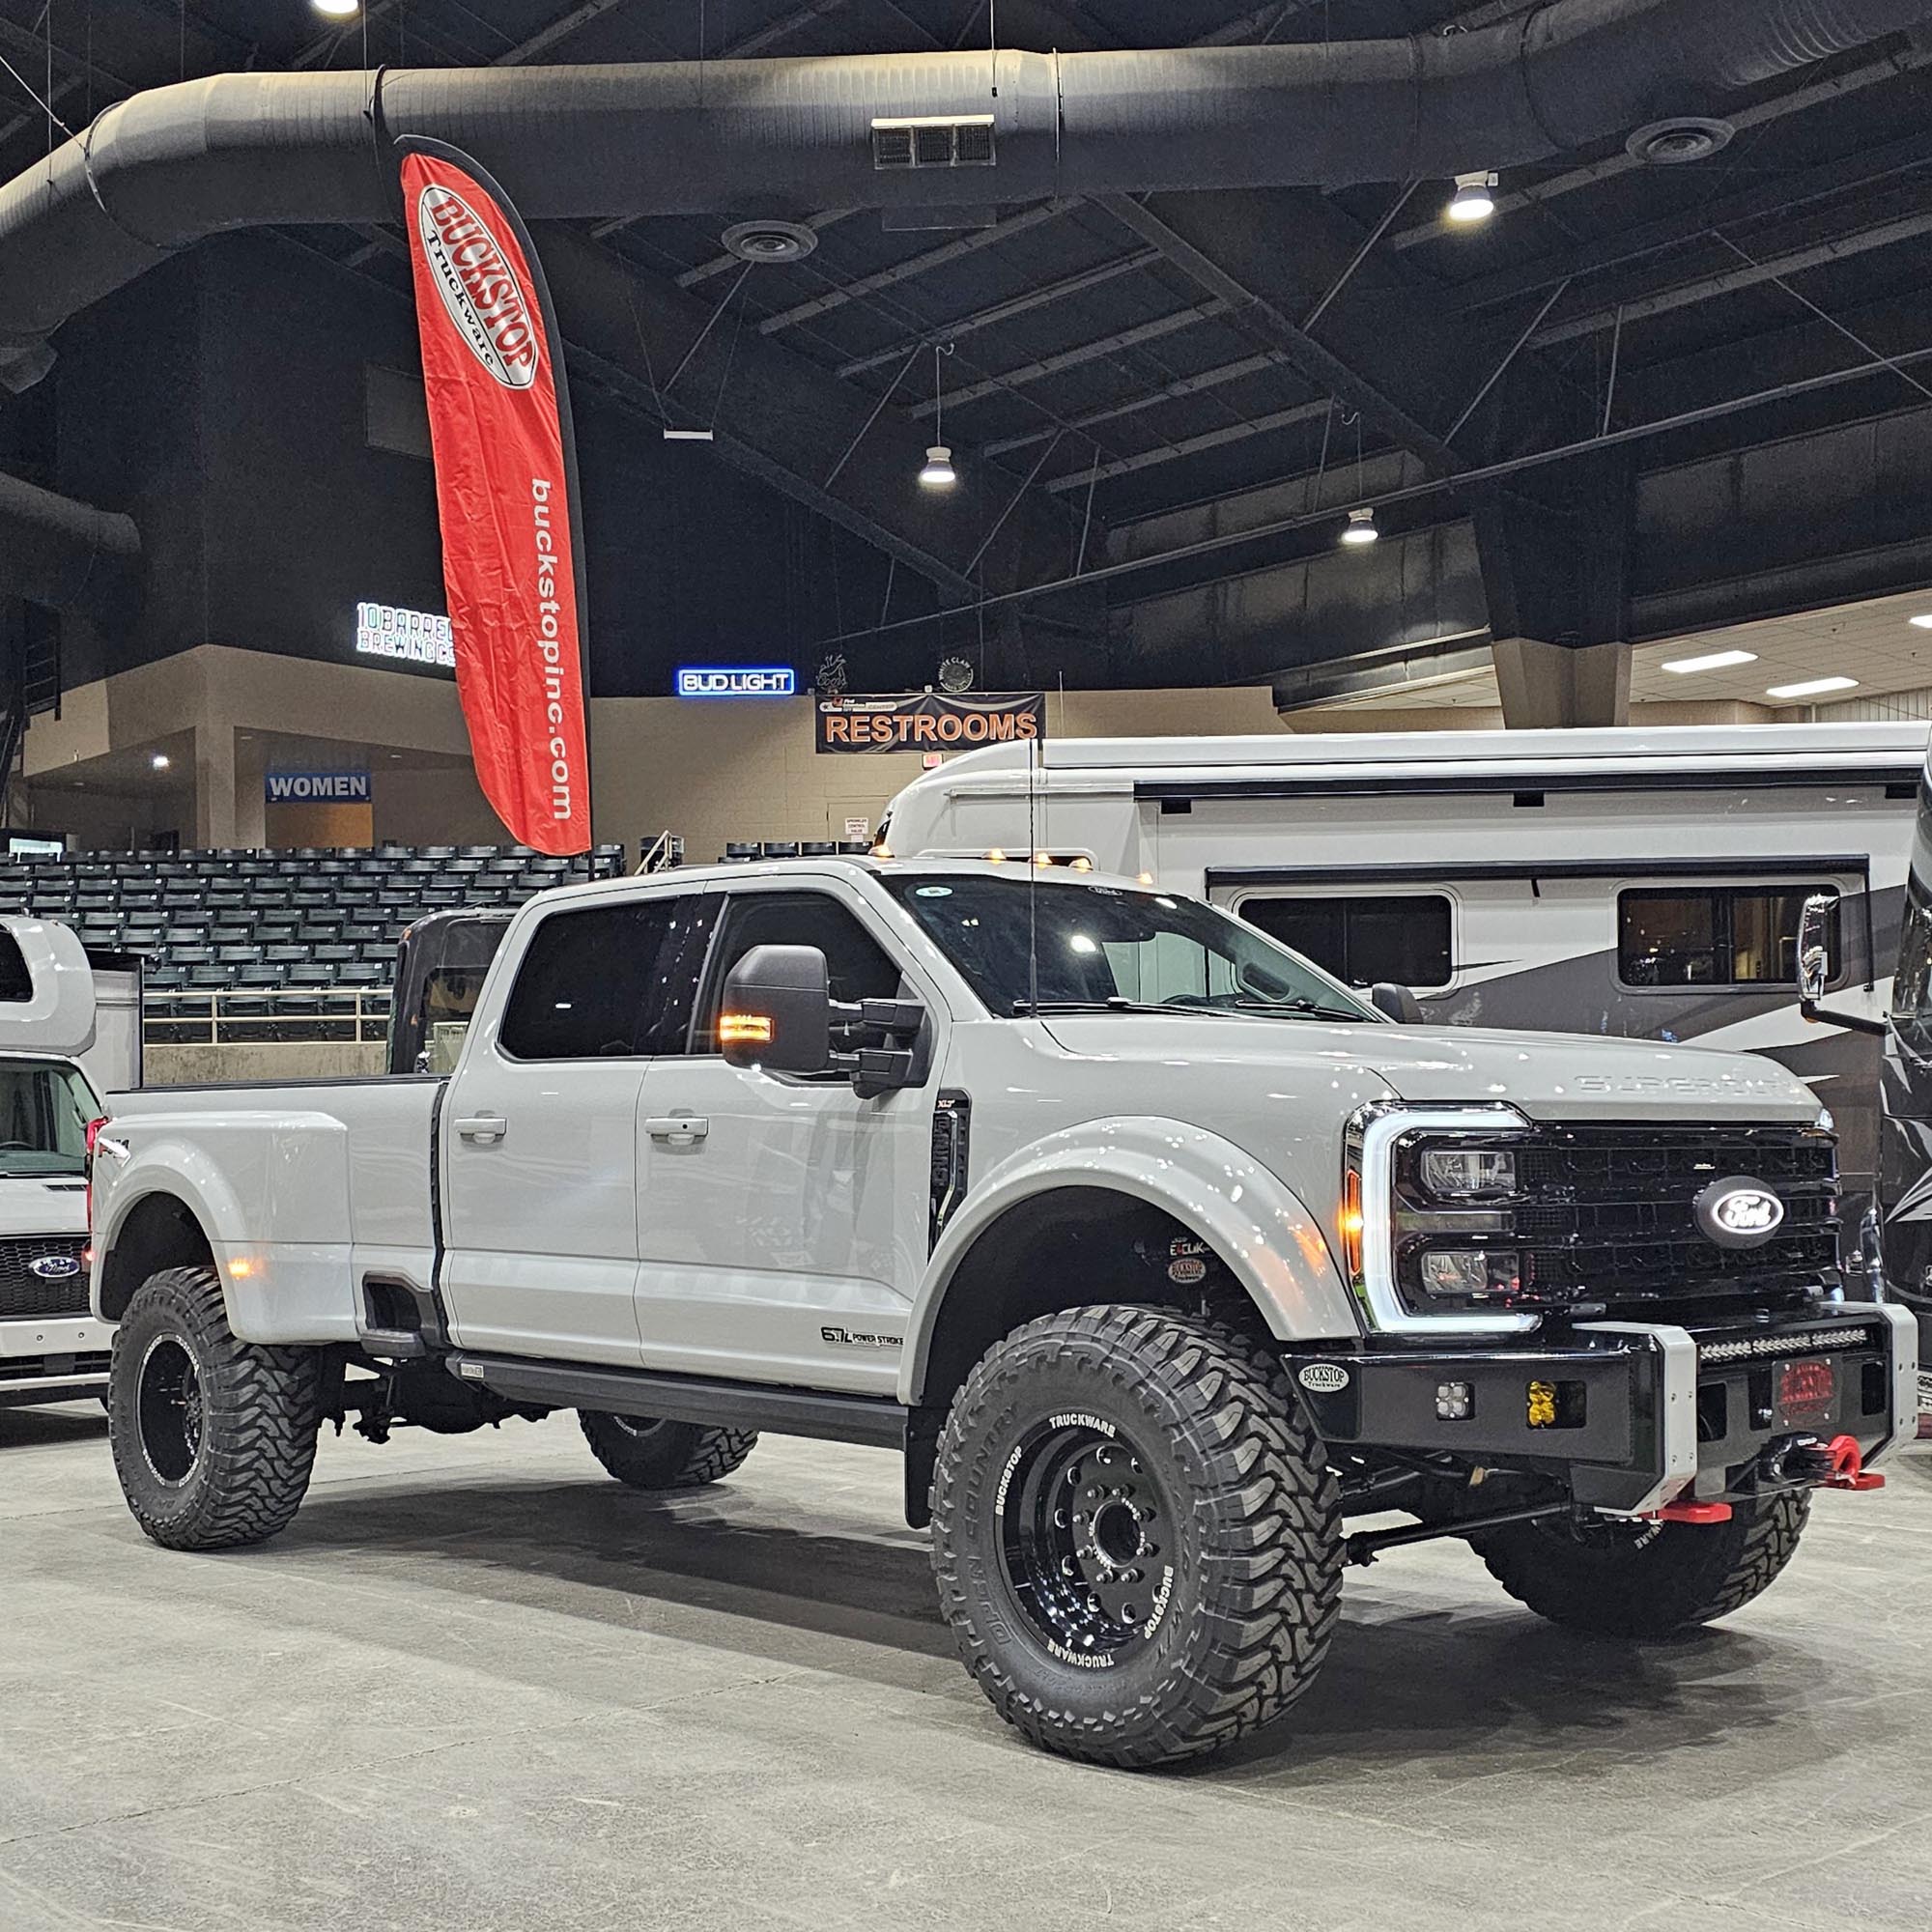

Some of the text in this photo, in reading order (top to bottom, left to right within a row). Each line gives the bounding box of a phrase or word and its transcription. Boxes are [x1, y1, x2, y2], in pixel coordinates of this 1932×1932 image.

[431, 196, 532, 367] BUCKSTOP
[427, 230, 494, 365] Truckware
[531, 477, 572, 820] buckstopinc.com
[683, 673, 788, 691] BUD LIGHT
[826, 713, 1037, 743] RESTROOMS
[270, 777, 367, 797] WOMEN
[937, 1099, 955, 1108] XLT
[1724, 1195, 1772, 1228] Ford
[820, 1327, 904, 1345] 6.7L POWER STROKE
[1304, 1366, 1345, 1382] BUCKSTOP
[1049, 1413, 1117, 1438] TRUCKWARE
[995, 1445, 1023, 1517] BUCKSTOP
[1144, 1565, 1174, 1639] BUCKSTOP
[1046, 1638, 1115, 1668] TRUCKWARE
